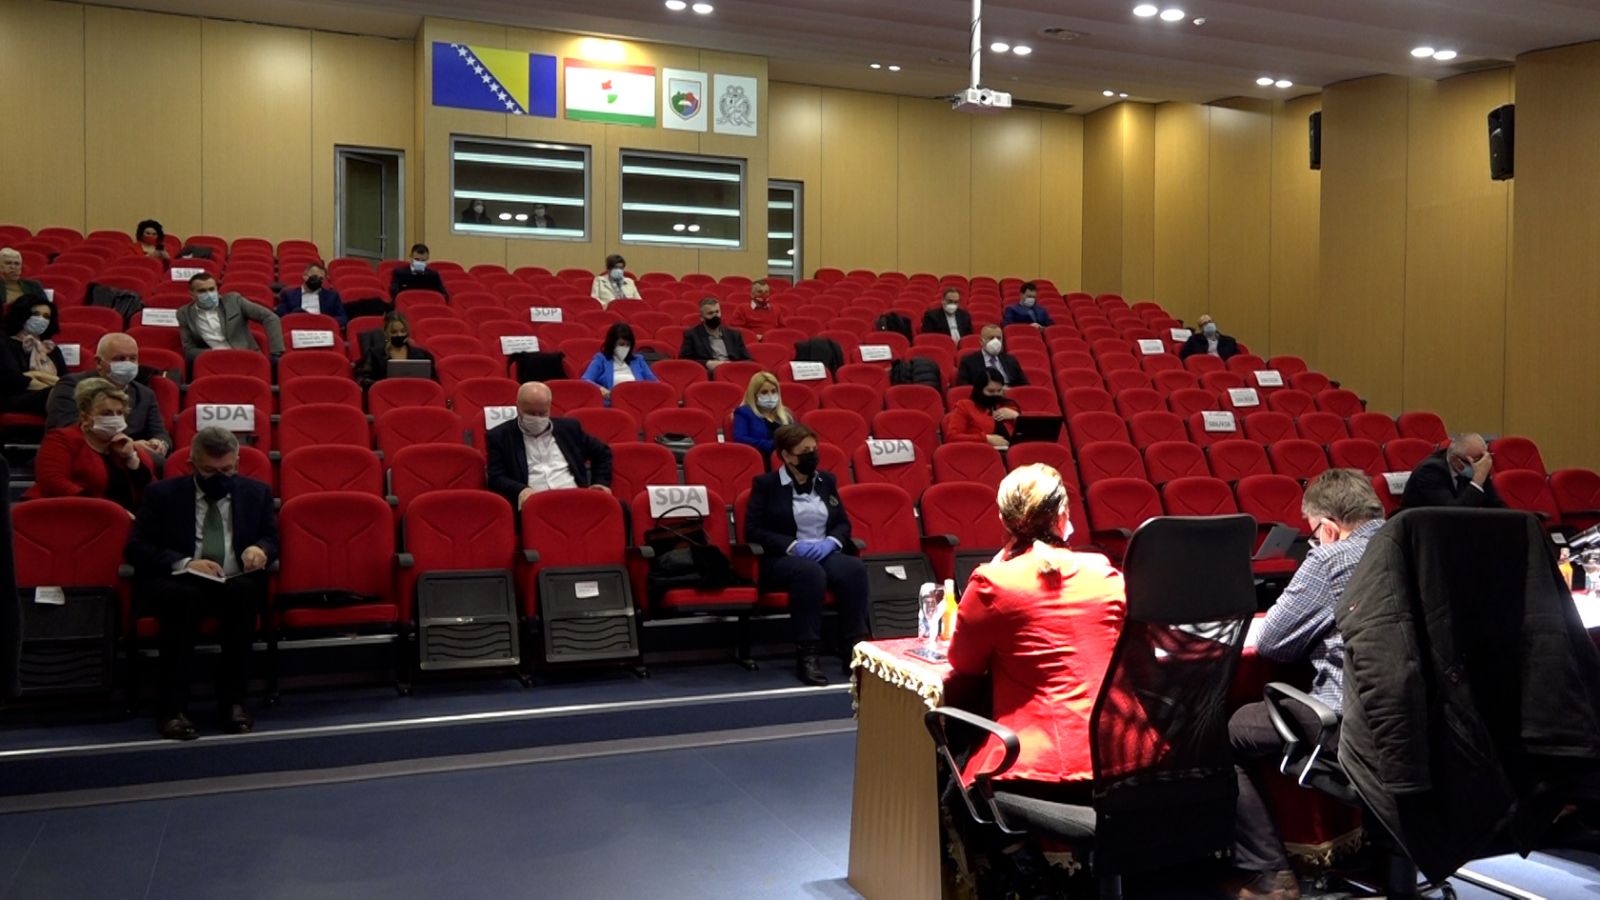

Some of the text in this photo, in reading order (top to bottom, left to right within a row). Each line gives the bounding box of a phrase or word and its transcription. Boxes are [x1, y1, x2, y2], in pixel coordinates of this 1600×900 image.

[202, 405, 249, 421] SDA
[490, 408, 516, 420] SD
[873, 440, 910, 456] SDA
[655, 487, 702, 506] SDA
